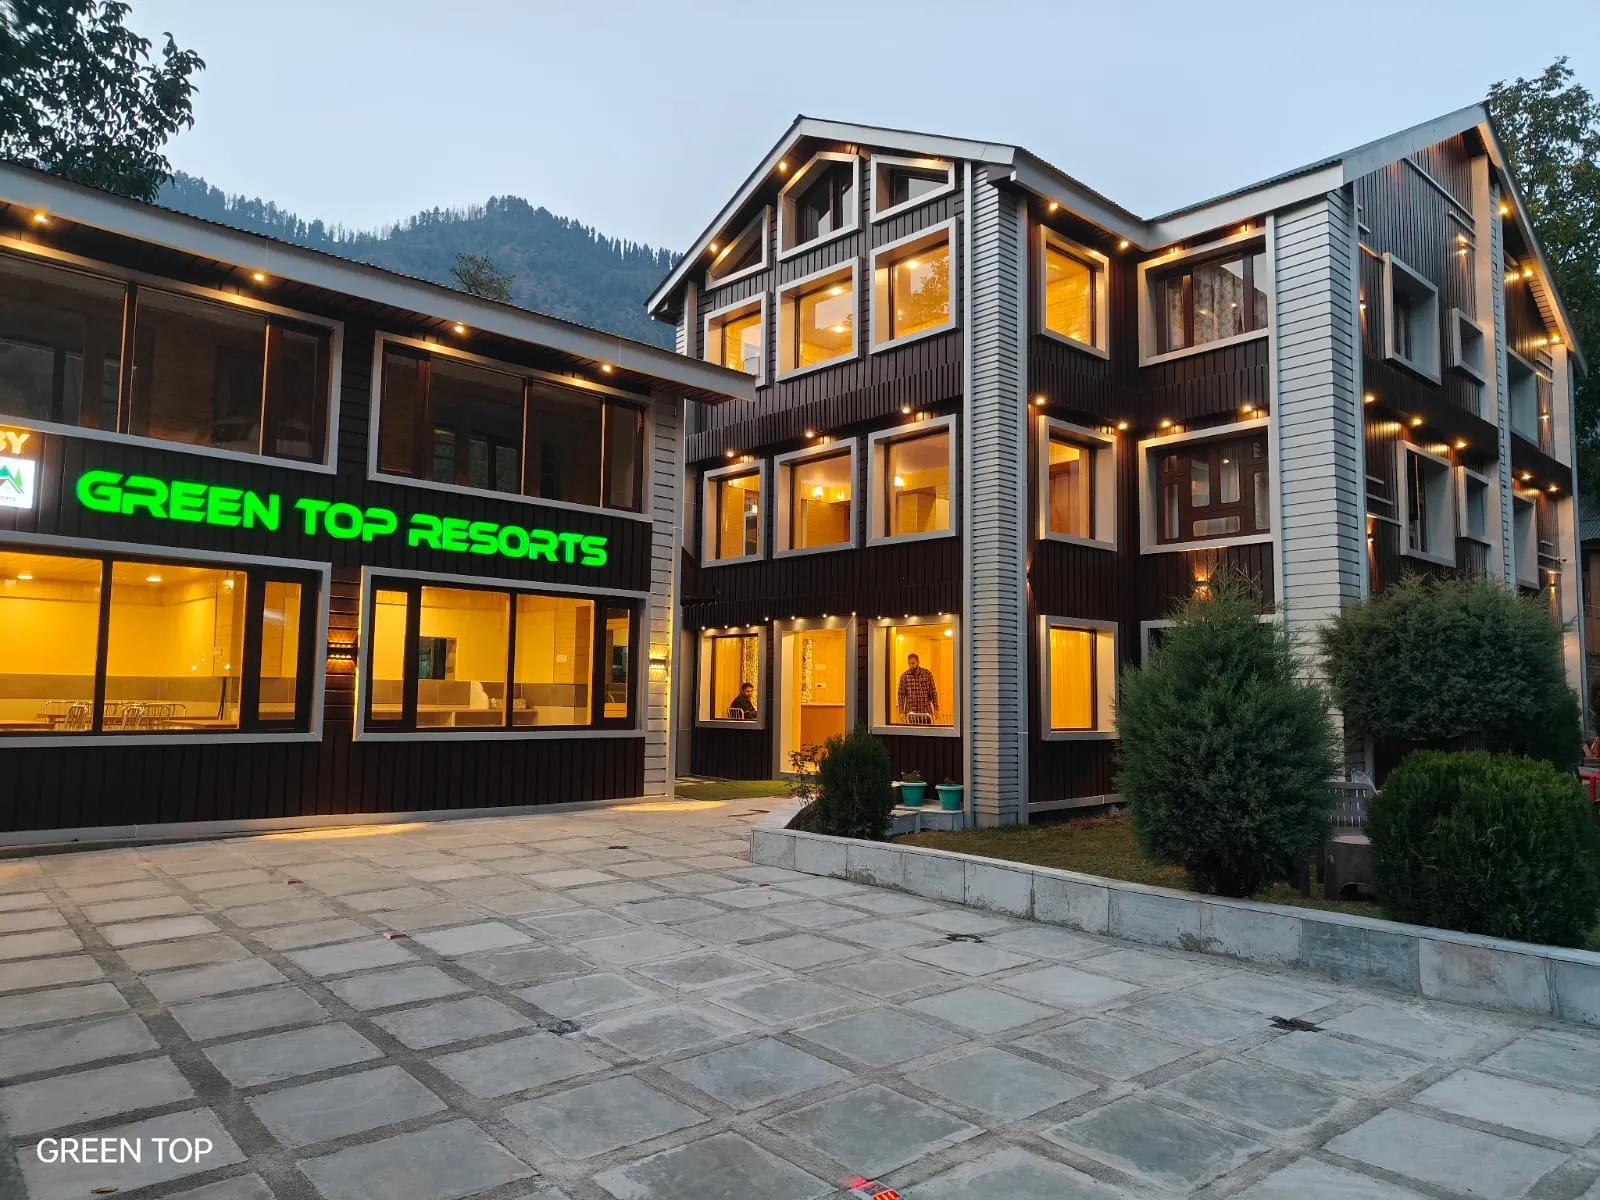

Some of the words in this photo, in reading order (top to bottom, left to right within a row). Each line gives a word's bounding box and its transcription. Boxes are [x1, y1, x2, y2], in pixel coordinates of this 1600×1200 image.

[76, 470, 280, 531] GREEN
[294, 498, 398, 542] TOP
[408, 513, 608, 567] RESORTS
